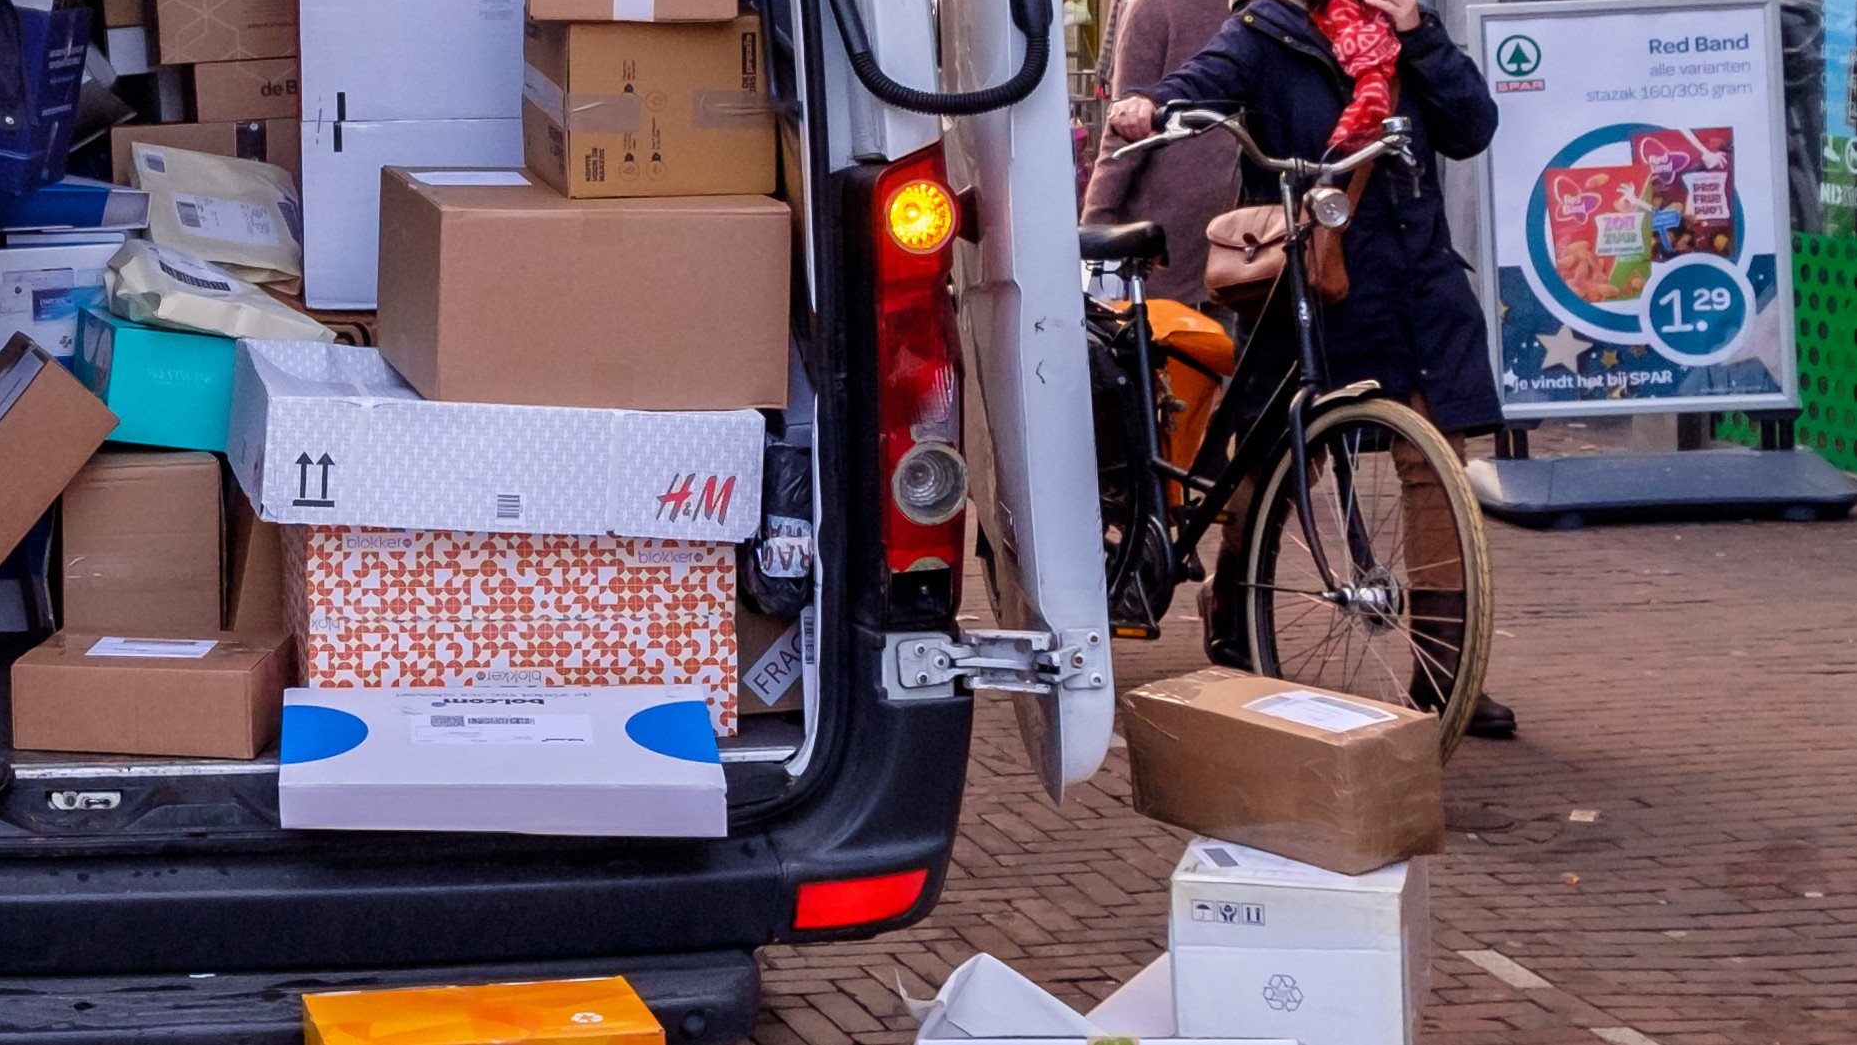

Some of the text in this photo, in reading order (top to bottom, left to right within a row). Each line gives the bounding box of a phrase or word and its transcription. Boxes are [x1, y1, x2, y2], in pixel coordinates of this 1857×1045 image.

[1649, 33, 1749, 55] Red Band
[1649, 60, 1751, 77] alle varianten
[261, 81, 283, 97] de
[1497, 80, 1544, 92] SPAR
[1586, 81, 1753, 103] stazak 160/305 gram
[1513, 377, 1527, 394] je
[1531, 375, 1575, 390] vindt
[1607, 372, 1627, 393] bij
[1629, 370, 1673, 385] SPAR
[656, 472, 737, 526] H&M
[346, 536, 401, 549] blokker
[638, 550, 695, 565] blokker
[486, 671, 542, 682] blokker
